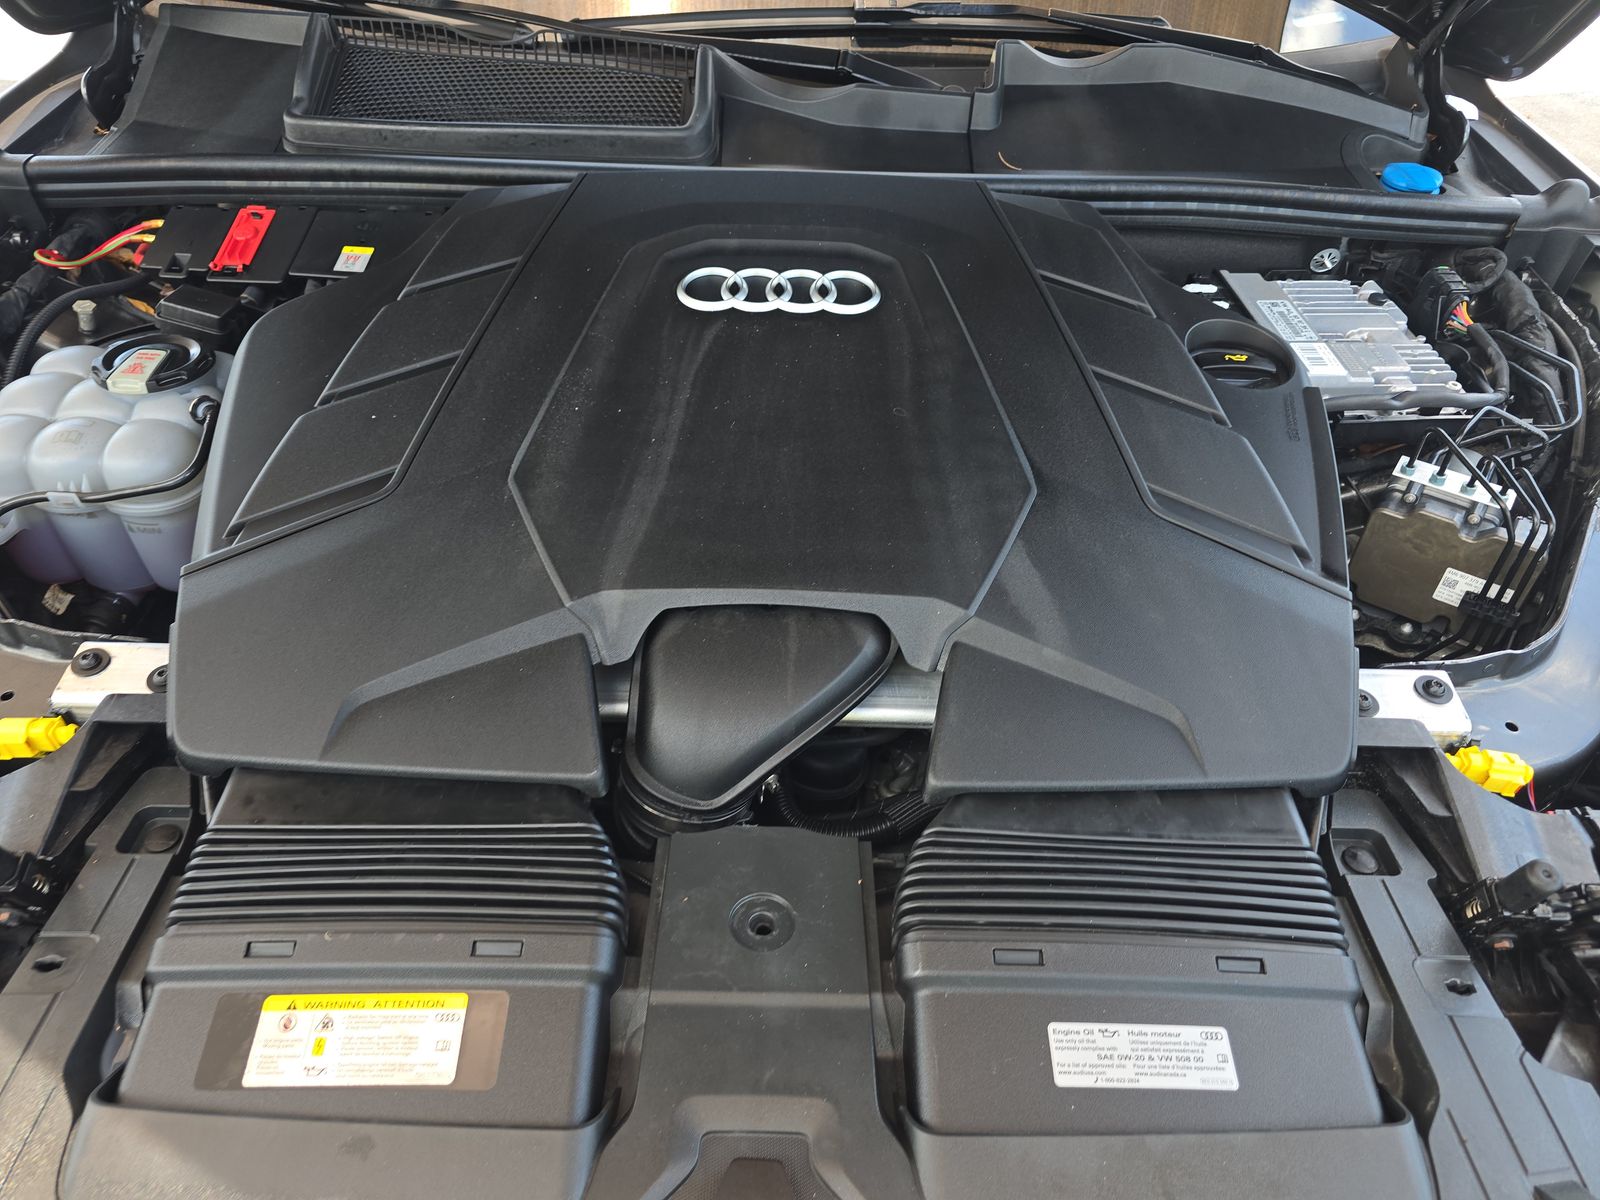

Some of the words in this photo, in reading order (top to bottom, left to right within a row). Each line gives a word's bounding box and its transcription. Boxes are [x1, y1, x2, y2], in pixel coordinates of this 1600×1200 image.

[304, 1000, 366, 1009] WARNING
[372, 1000, 445, 1009] ATTENTION
[1052, 1028, 1080, 1036] Engine
[1083, 1028, 1094, 1036] Oil
[1127, 1029, 1148, 1037] Huile
[1150, 1030, 1181, 1038] moteur
[1096, 1053, 1115, 1061] SAE
[1117, 1053, 1145, 1061] 0W-20
[1148, 1054, 1155, 1062] &
[1175, 1055, 1191, 1063] 508
[1193, 1055, 1204, 1063] 00
